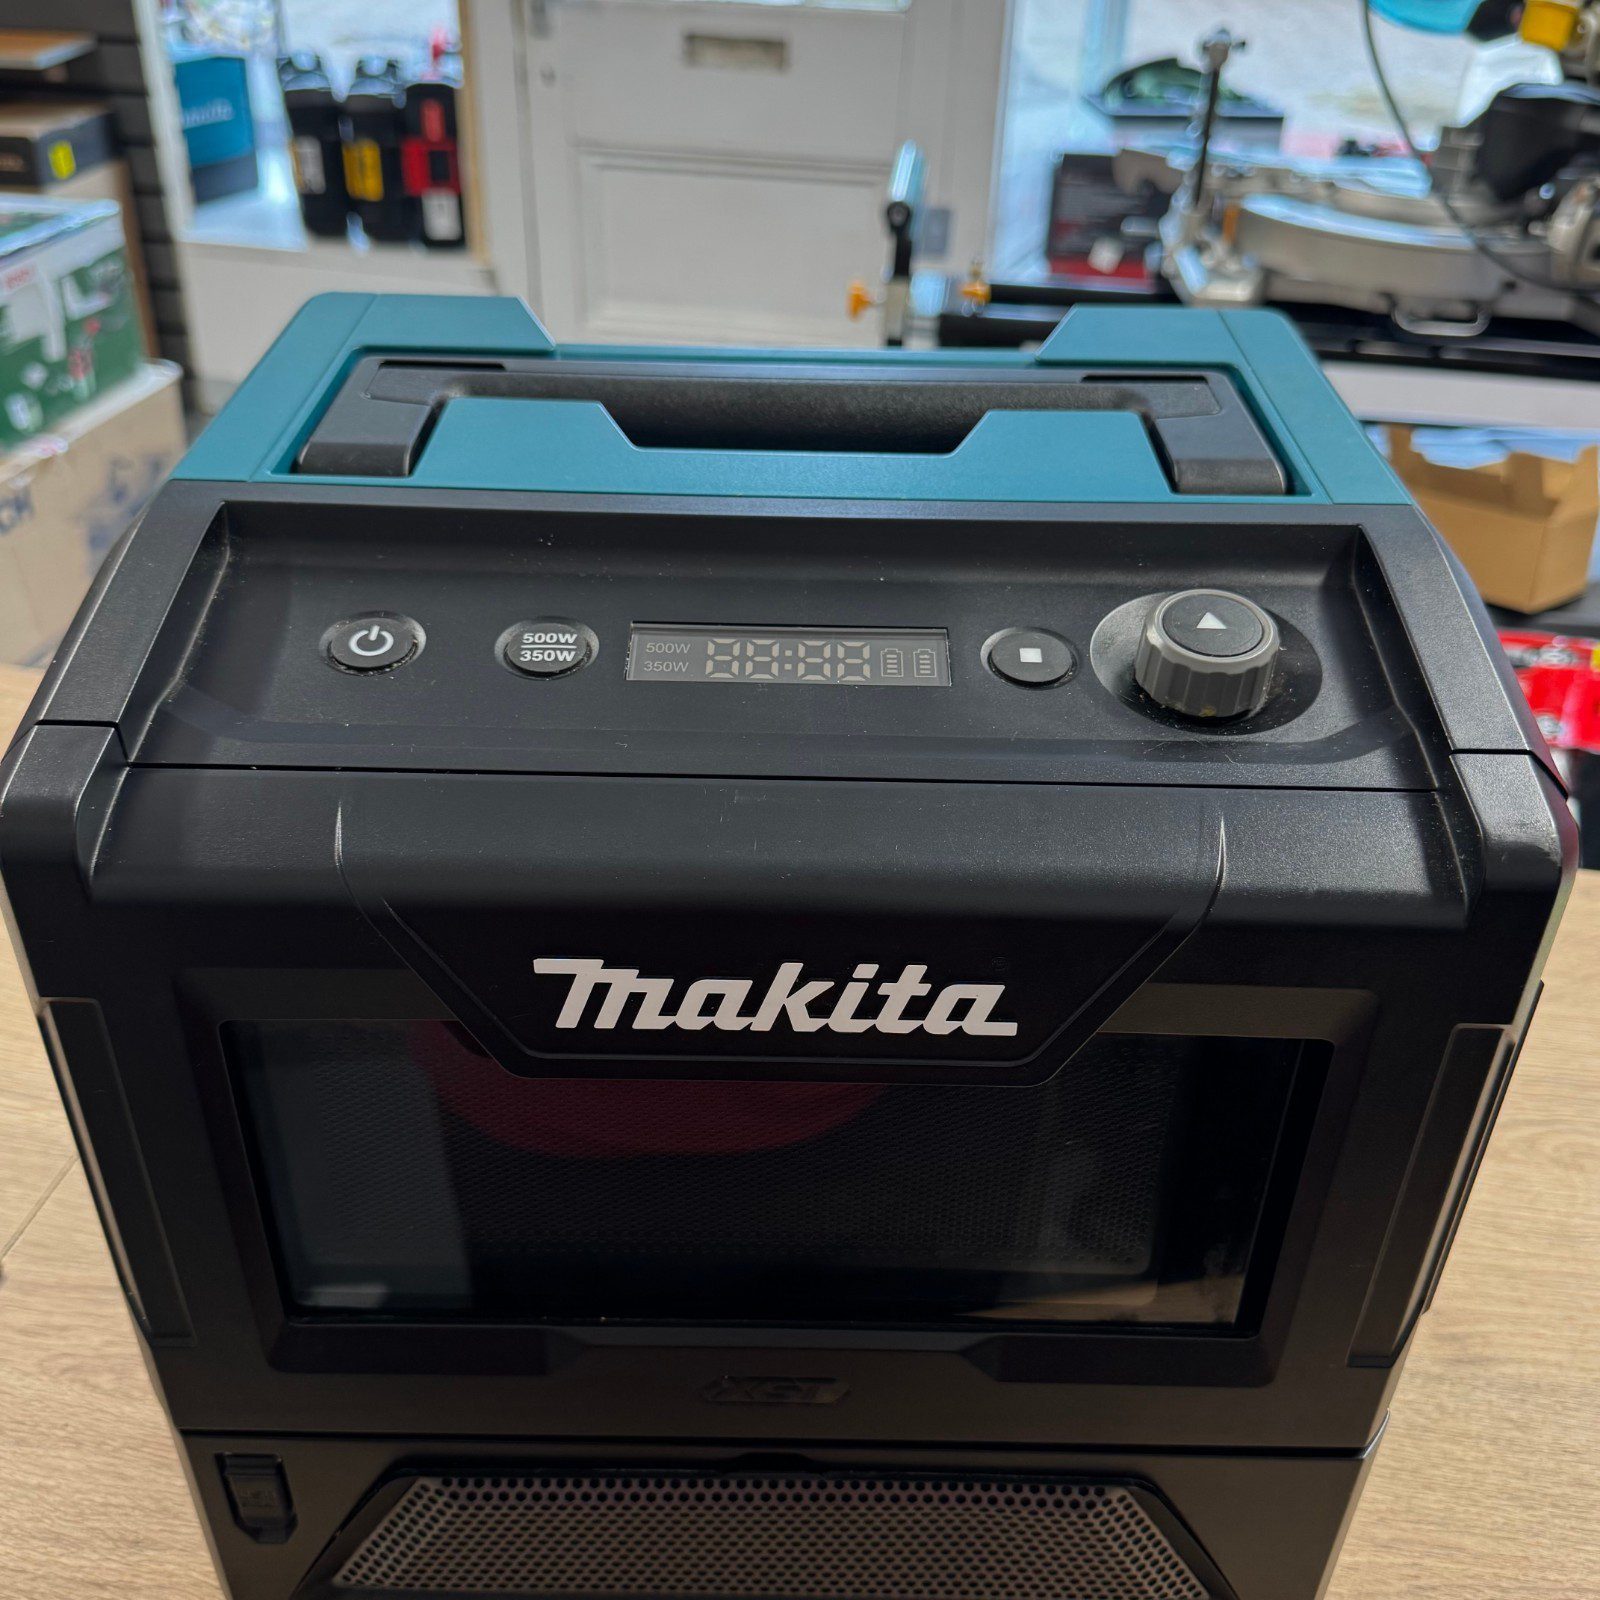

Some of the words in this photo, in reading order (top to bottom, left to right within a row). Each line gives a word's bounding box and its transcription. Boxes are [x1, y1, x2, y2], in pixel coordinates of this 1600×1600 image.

[522, 632, 578, 645] 500W
[645, 642, 691, 654] 500W
[519, 650, 576, 662] 350W
[643, 661, 690, 673] 350W
[533, 958, 1018, 1037] makita
